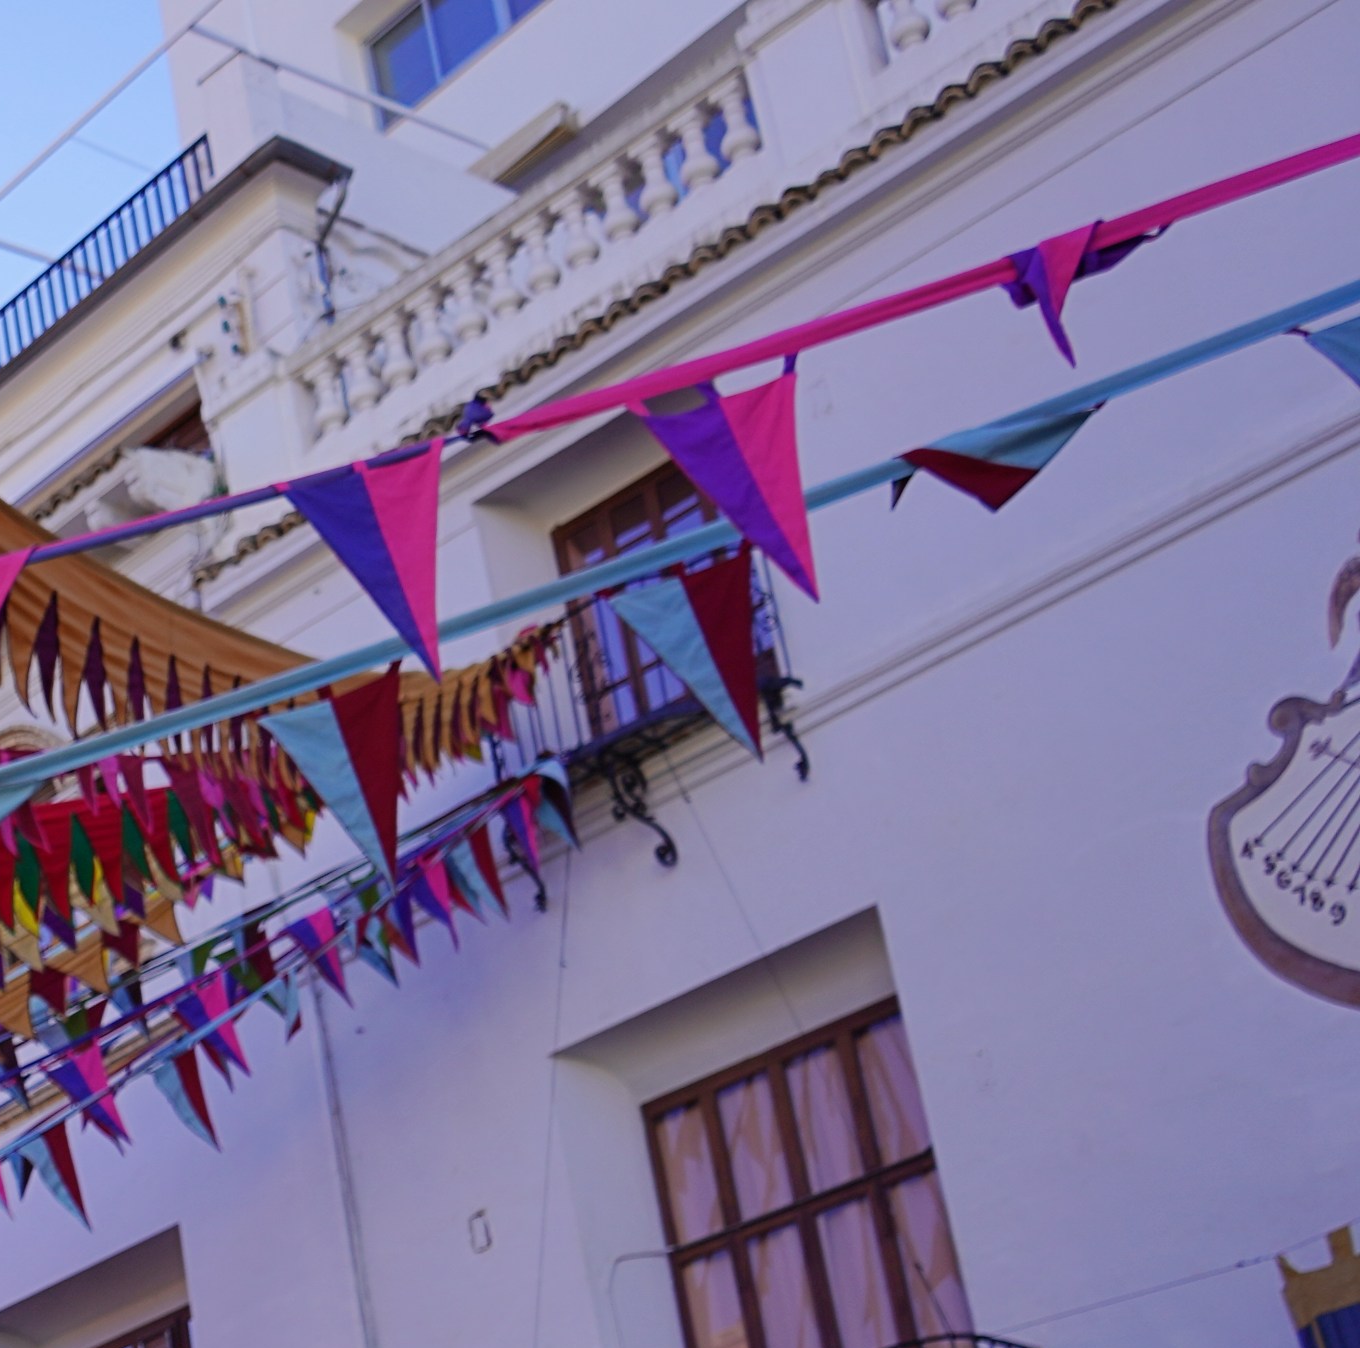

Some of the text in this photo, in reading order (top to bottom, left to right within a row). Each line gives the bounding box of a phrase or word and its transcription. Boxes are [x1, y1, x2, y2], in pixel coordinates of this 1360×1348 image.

[1276, 870, 1291, 889] 6
[1310, 890, 1325, 911] 8
[1329, 902, 1346, 926] 9
